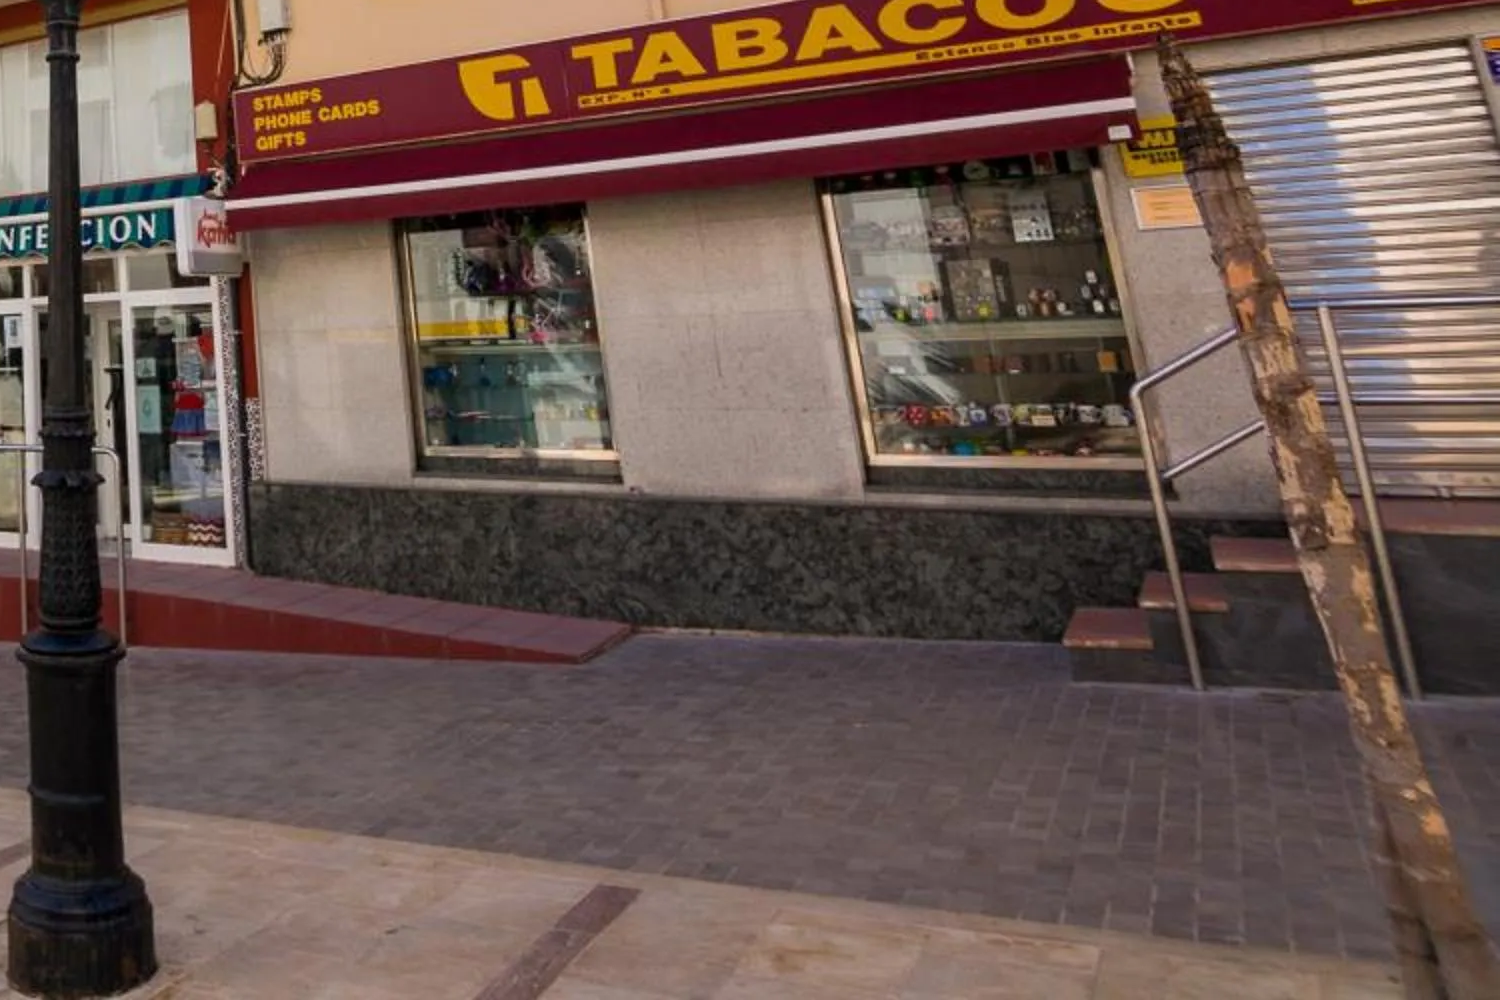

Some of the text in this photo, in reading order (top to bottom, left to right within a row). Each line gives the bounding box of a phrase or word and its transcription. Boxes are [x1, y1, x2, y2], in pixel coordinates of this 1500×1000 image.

[252, 87, 323, 112] STAMPS
[253, 99, 380, 132] PHONE CARDS
[255, 130, 307, 151] GIFTS
